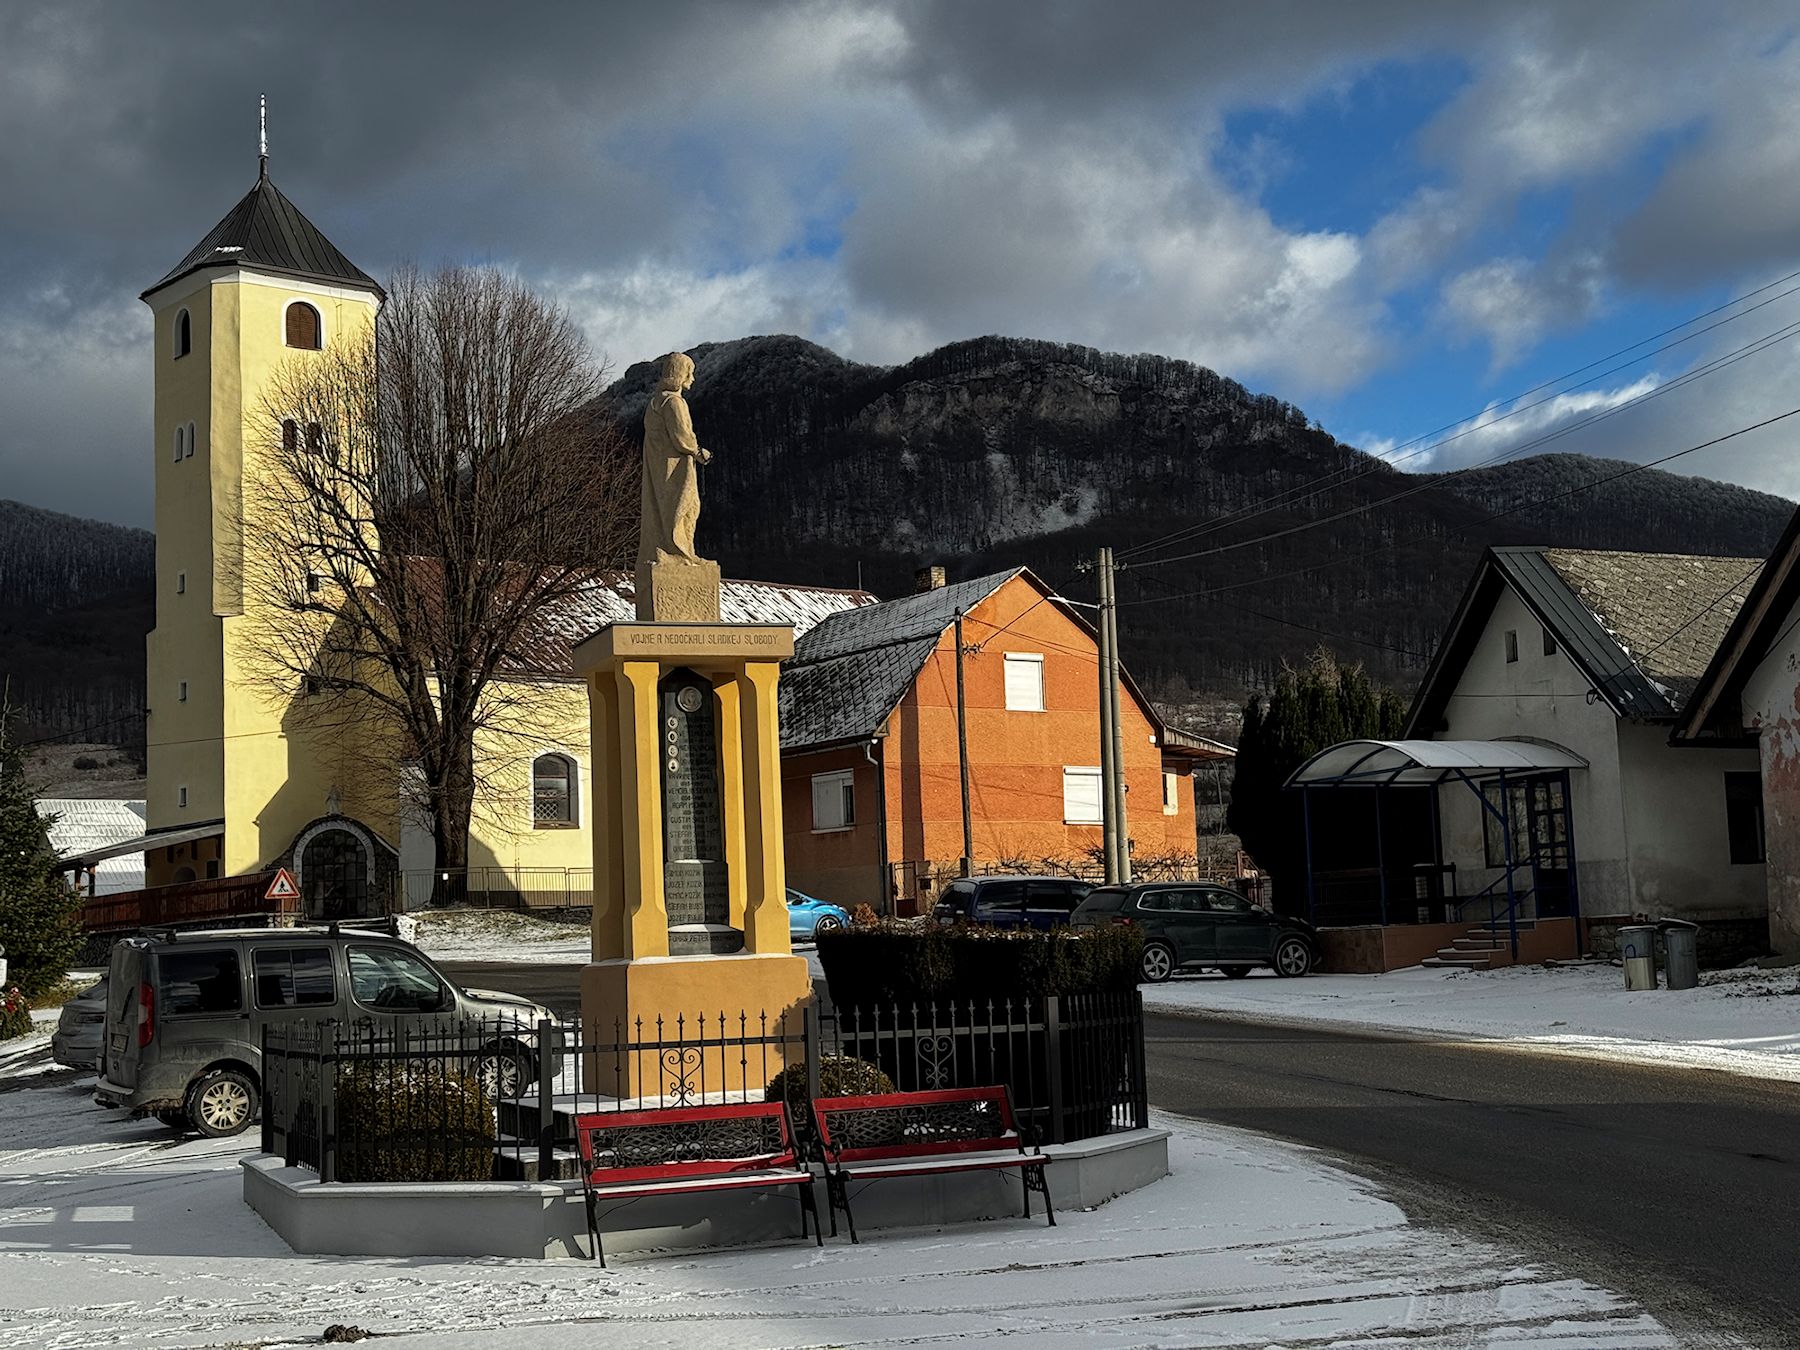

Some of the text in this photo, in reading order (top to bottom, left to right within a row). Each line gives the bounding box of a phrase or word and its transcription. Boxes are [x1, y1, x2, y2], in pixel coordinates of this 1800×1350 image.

[630, 633, 655, 645] VOJNE
[707, 633, 741, 645] SLADKEJ
[744, 633, 778, 645] SLOBODY
